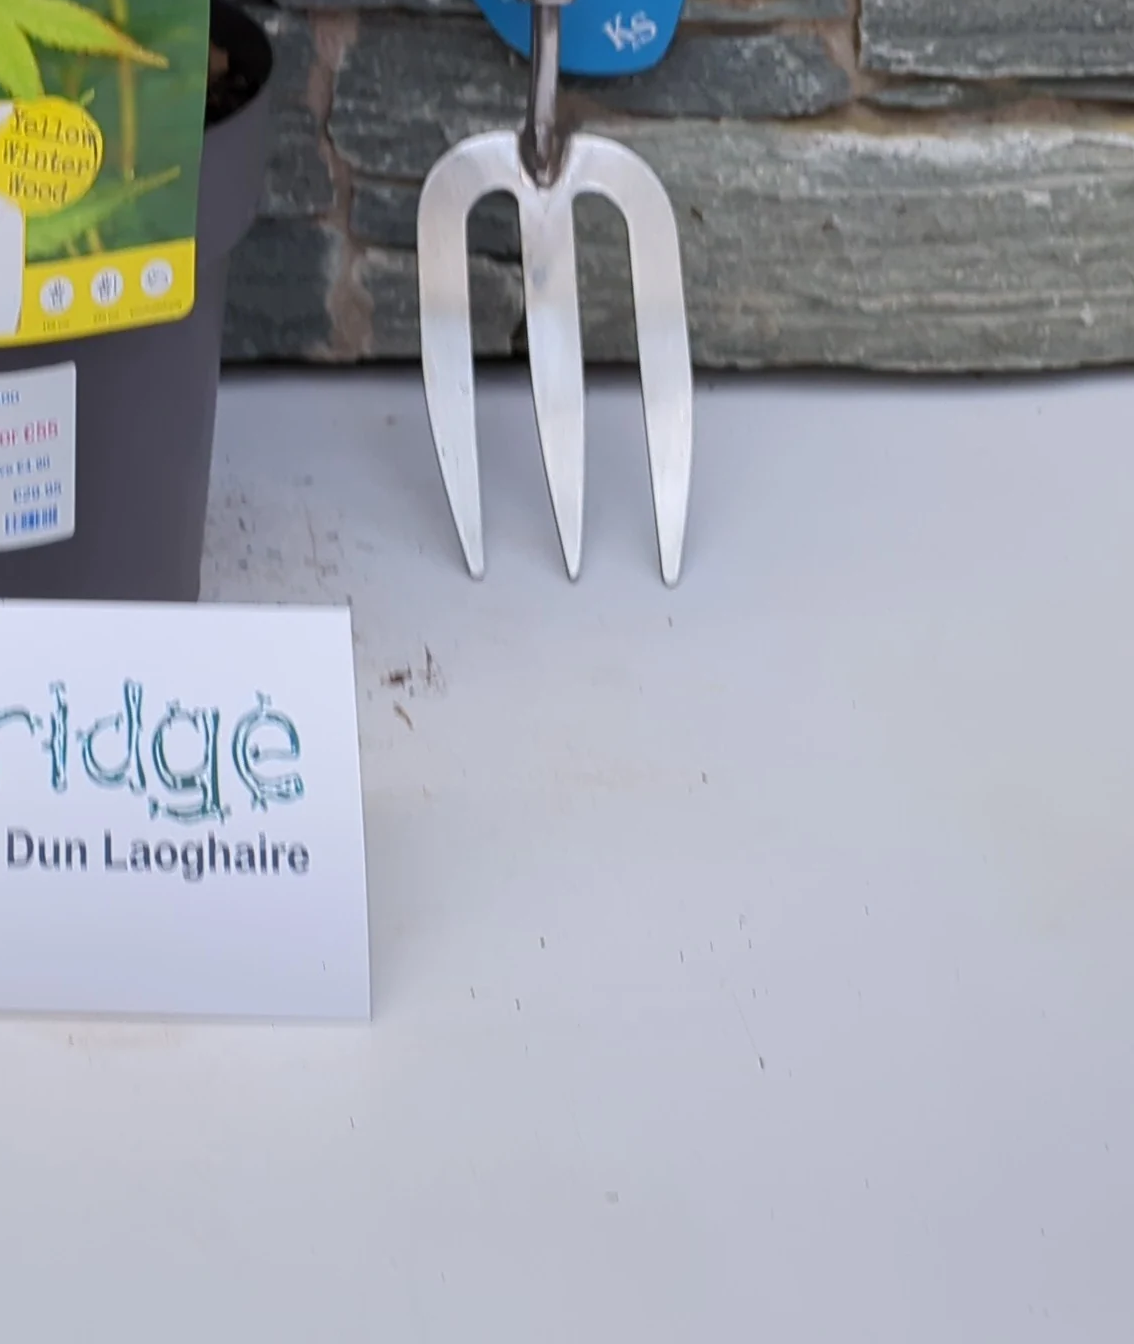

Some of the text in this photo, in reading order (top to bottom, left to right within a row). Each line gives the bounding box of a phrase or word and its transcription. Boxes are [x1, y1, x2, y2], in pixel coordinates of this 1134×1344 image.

[11, 108, 96, 150] Yellow
[3, 139, 92, 177] Winter
[8, 171, 69, 205] Wood
[6, 829, 88, 872] Dun
[103, 831, 311, 884] Laoghaire
